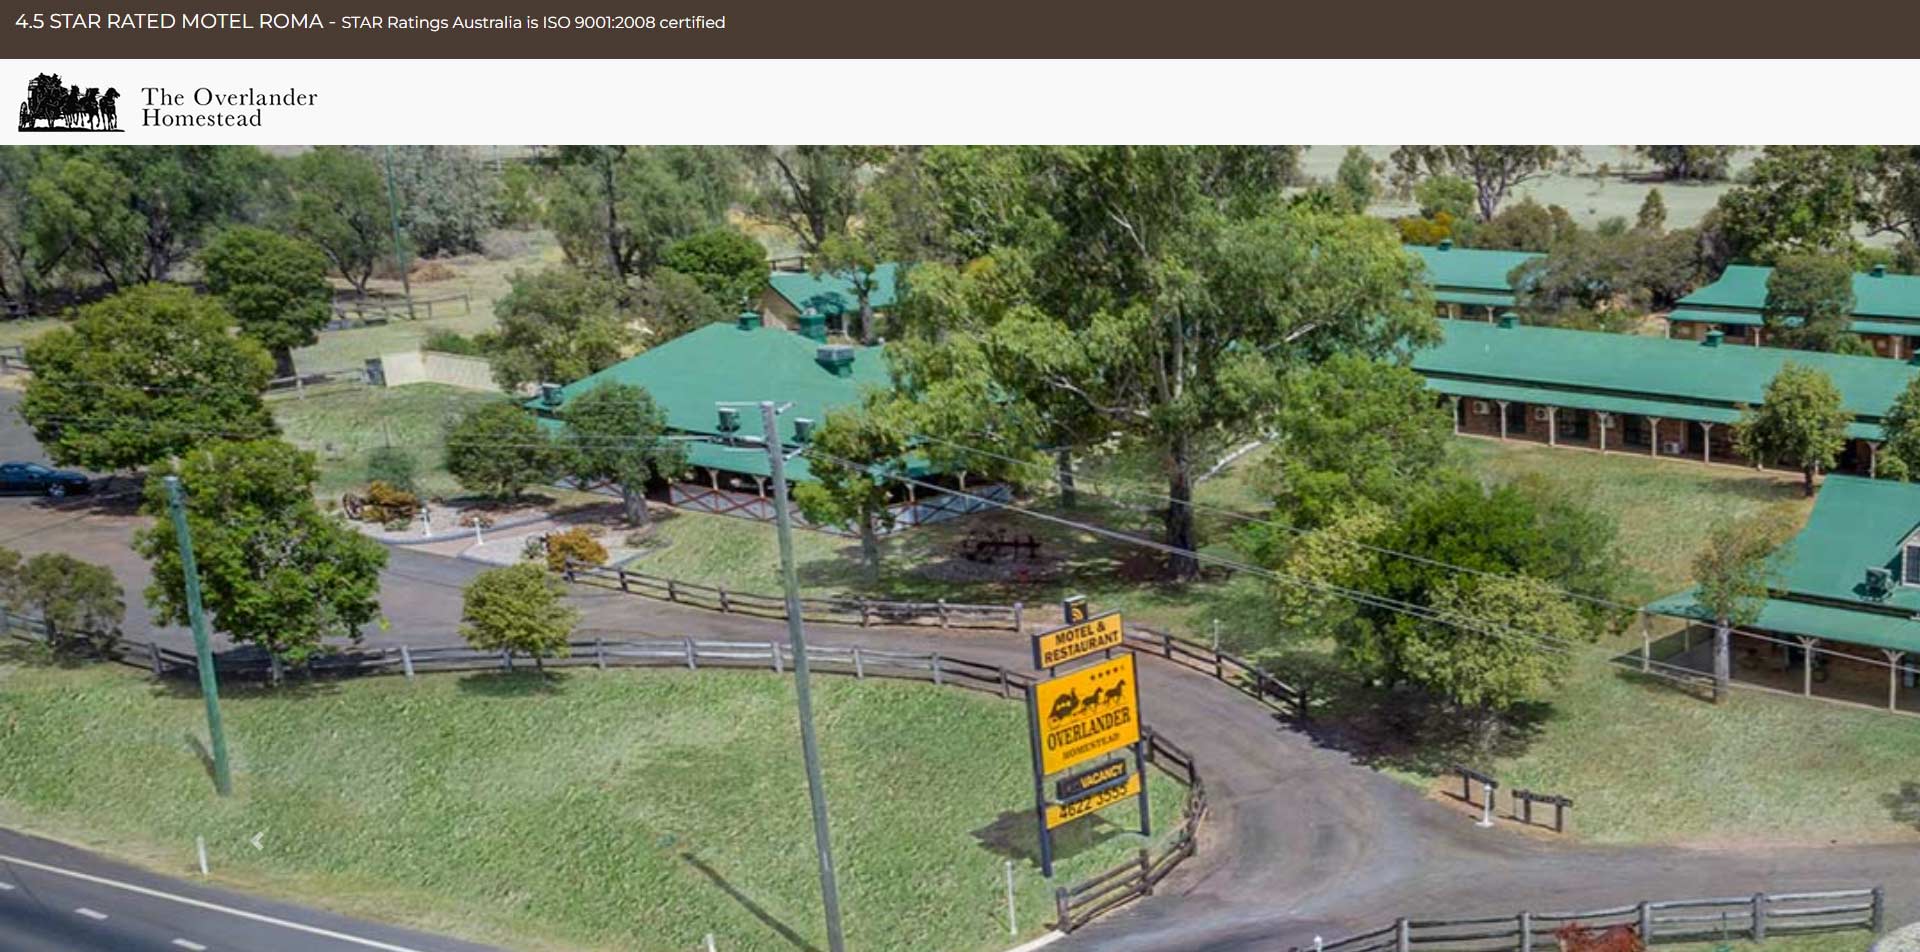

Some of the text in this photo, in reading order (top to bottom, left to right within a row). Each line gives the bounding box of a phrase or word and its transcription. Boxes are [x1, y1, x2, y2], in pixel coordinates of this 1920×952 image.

[1044, 629, 1119, 665] RESTAURANT
[1055, 620, 1106, 646] MOTEL &
[1047, 705, 1131, 752] OVERLANDER
[1080, 762, 1125, 789] VACANCY
